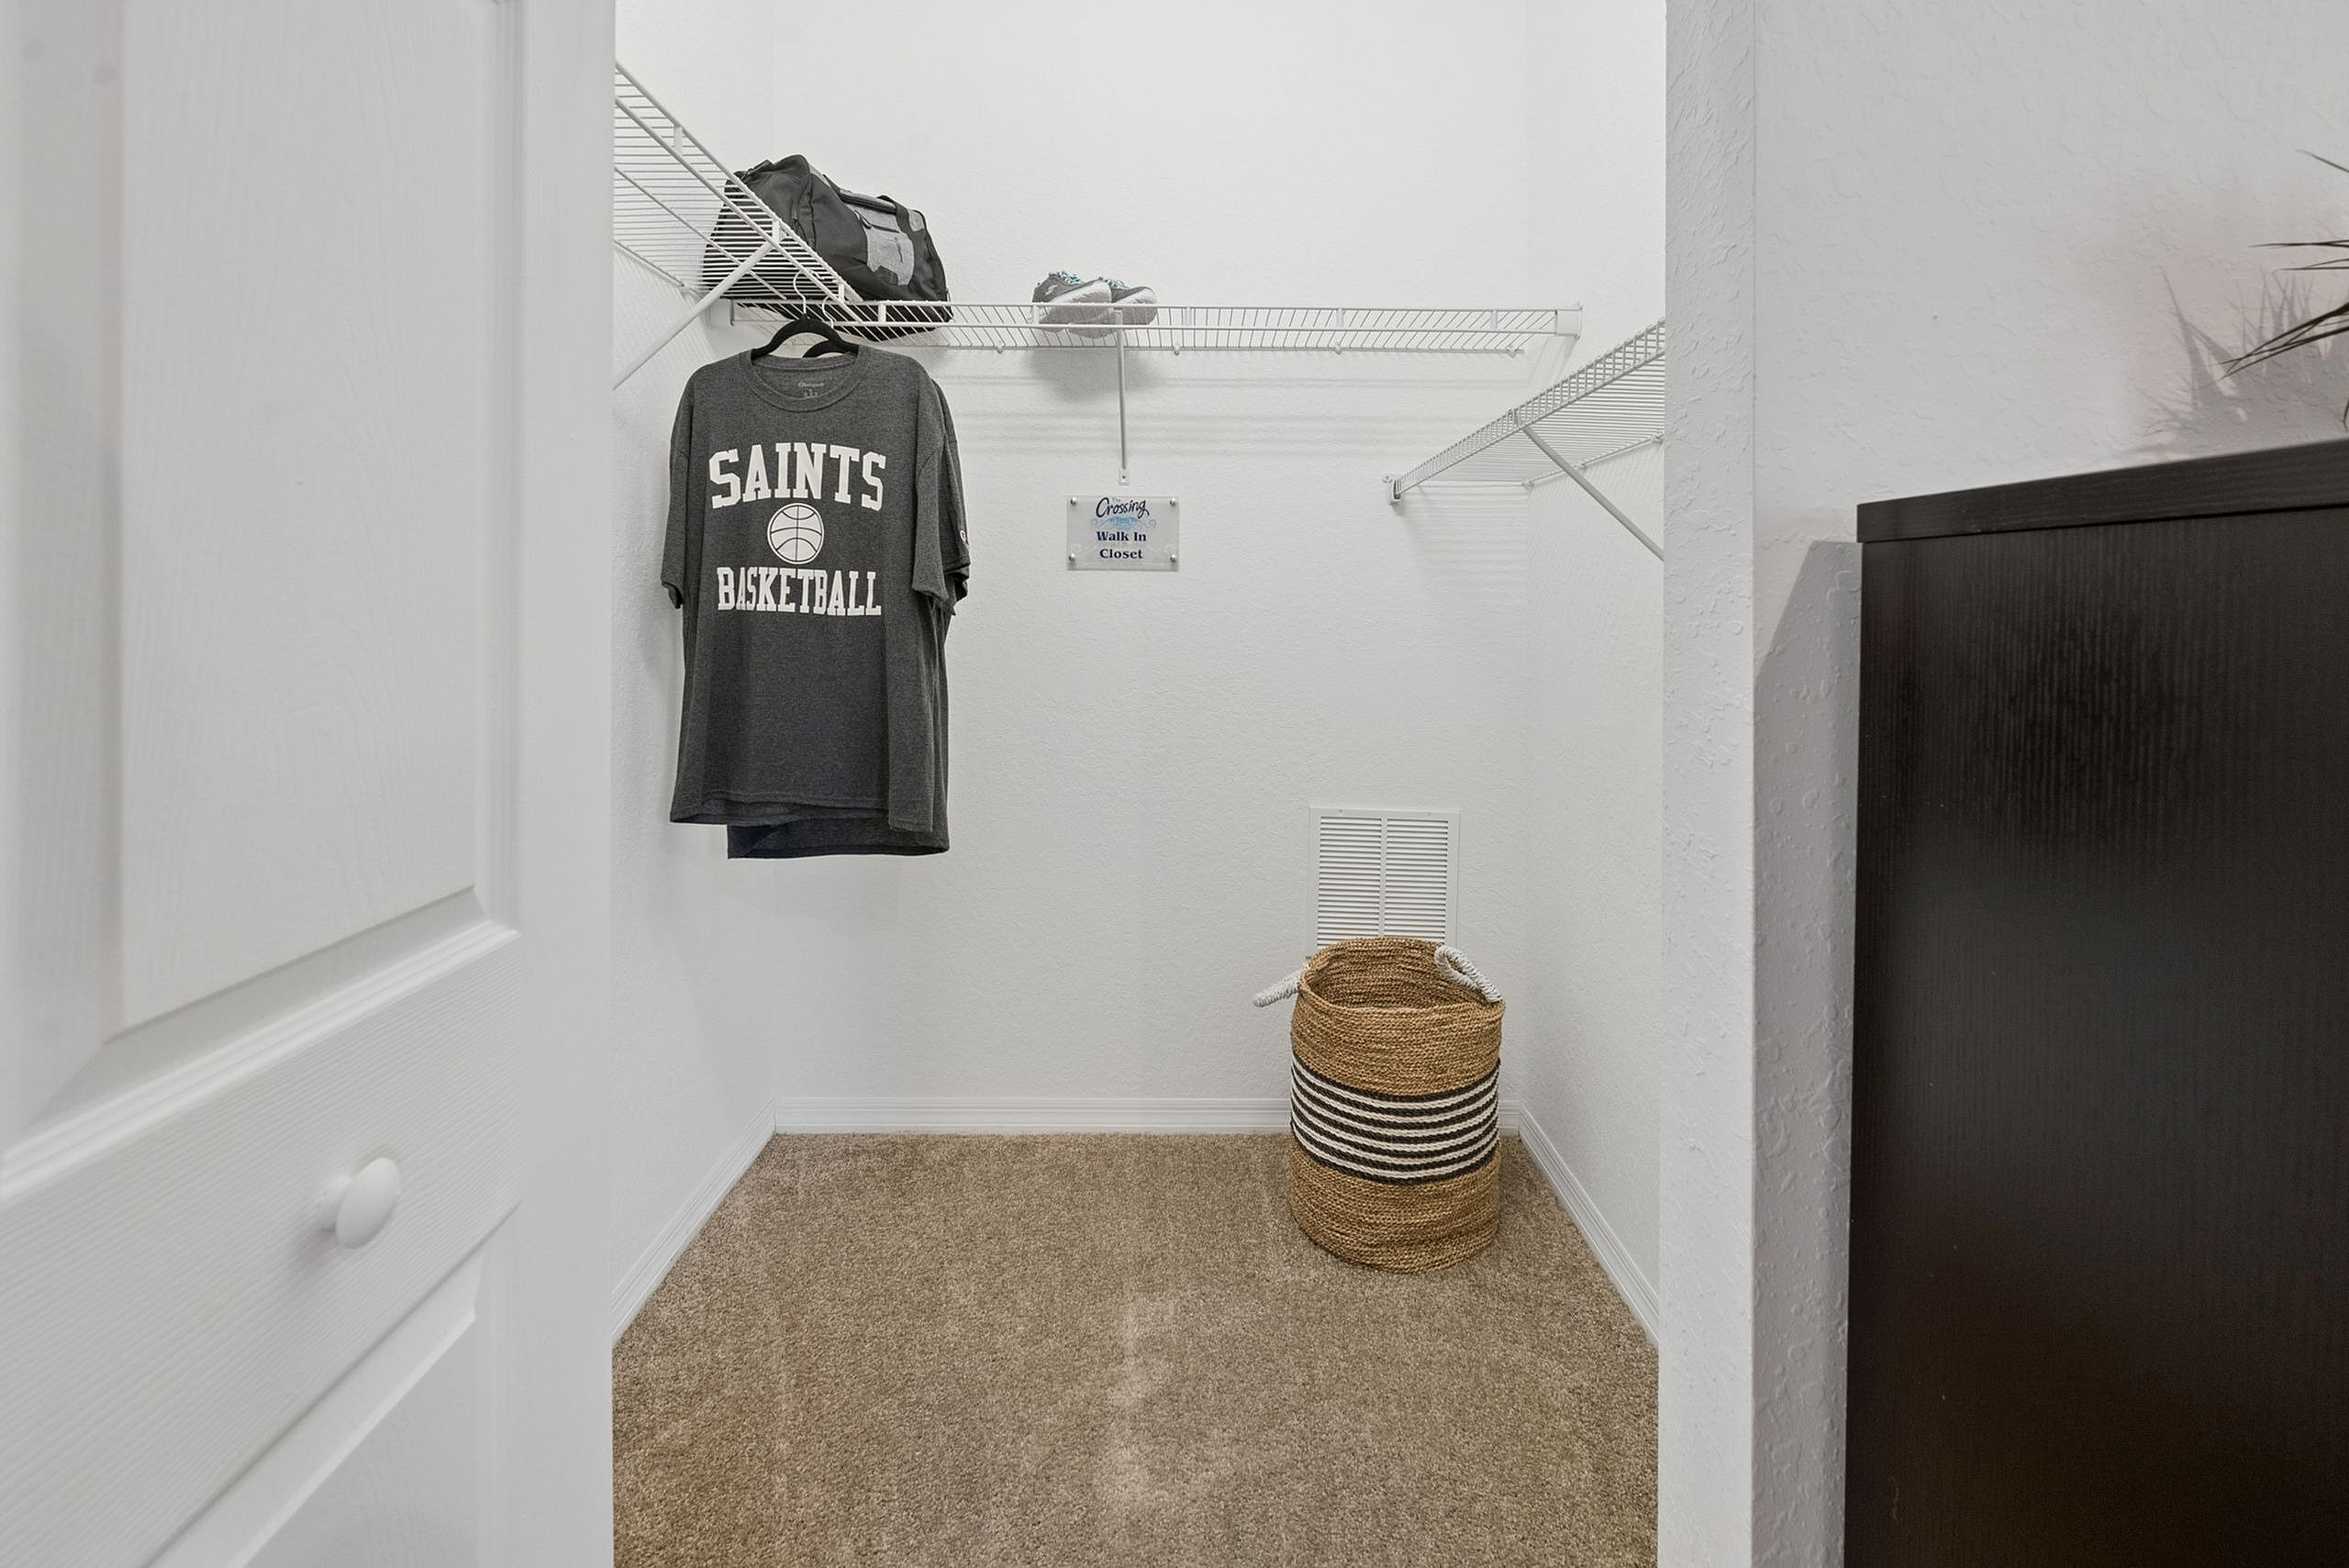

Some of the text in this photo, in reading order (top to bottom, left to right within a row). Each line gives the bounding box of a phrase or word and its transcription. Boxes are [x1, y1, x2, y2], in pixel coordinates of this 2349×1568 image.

[709, 442, 886, 511] SAINTS
[1096, 496, 1150, 518] Crossing
[1097, 531, 1147, 541] Walk In
[1099, 549, 1143, 559] Closet
[717, 566, 882, 616] BASKETBALL
